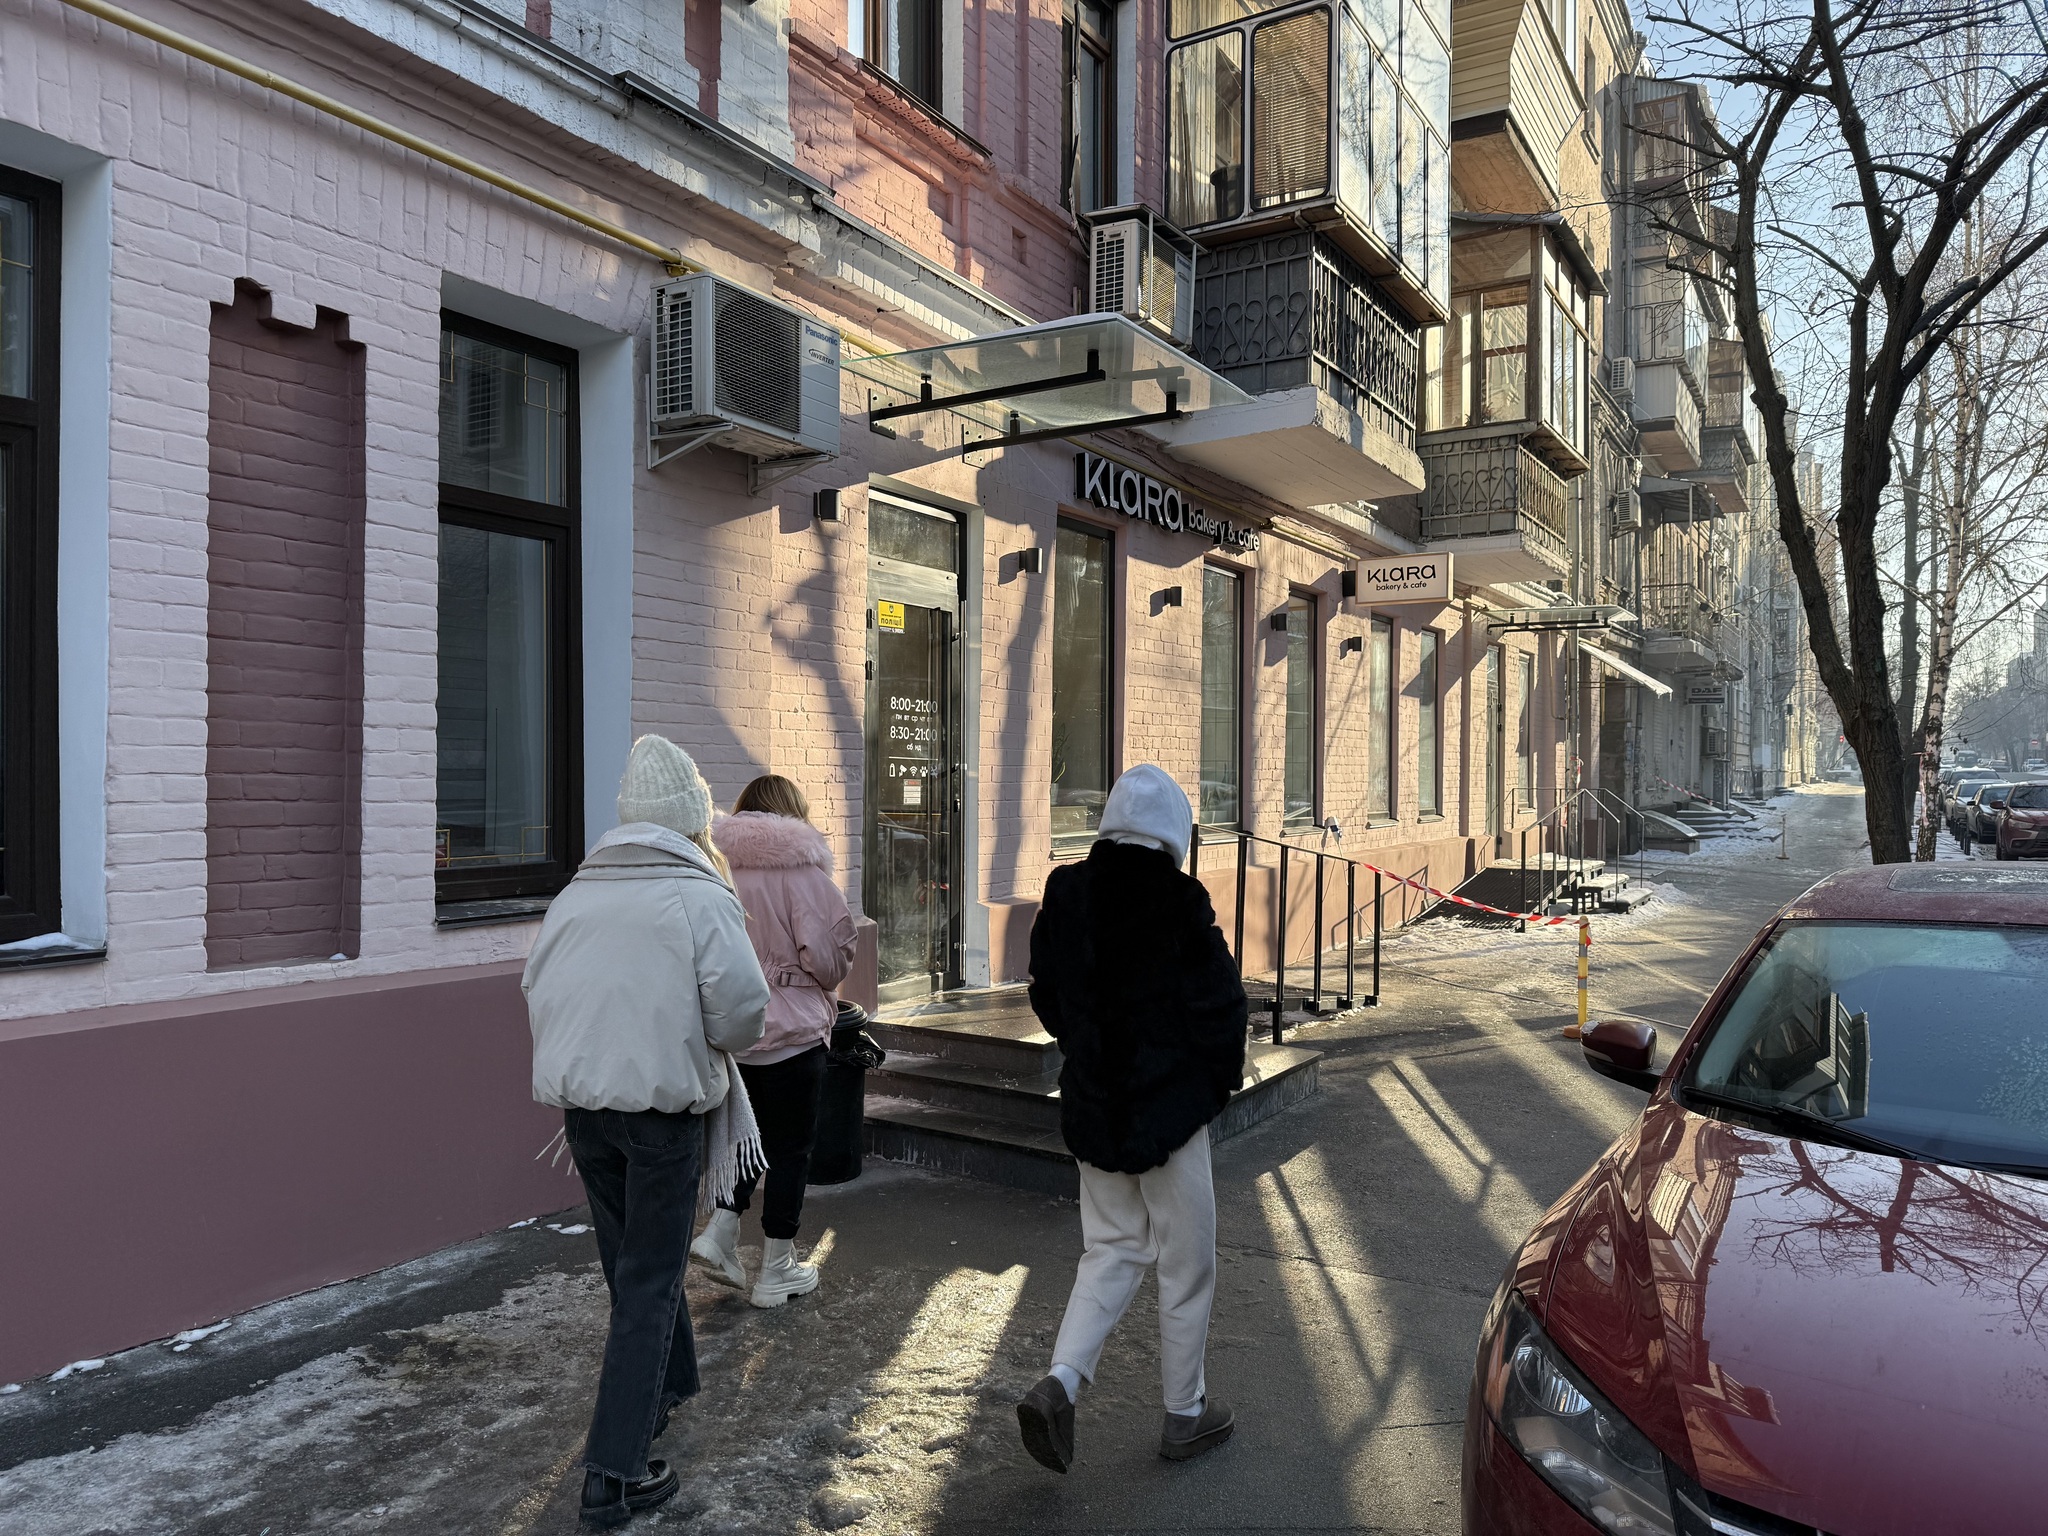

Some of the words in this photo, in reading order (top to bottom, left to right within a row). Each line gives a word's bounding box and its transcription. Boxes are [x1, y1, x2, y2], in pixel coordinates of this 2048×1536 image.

[805, 325, 838, 346] Panasonic
[810, 351, 835, 366] INVERTER
[1188, 503, 1226, 545] bakery
[1228, 520, 1237, 543] &
[1239, 527, 1261, 552] cafe
[1375, 583, 1401, 592] bakery
[1410, 580, 1427, 589] cafe
[890, 696, 938, 713] 8:00-21:00
[890, 725, 938, 742] 8:30-21:00
